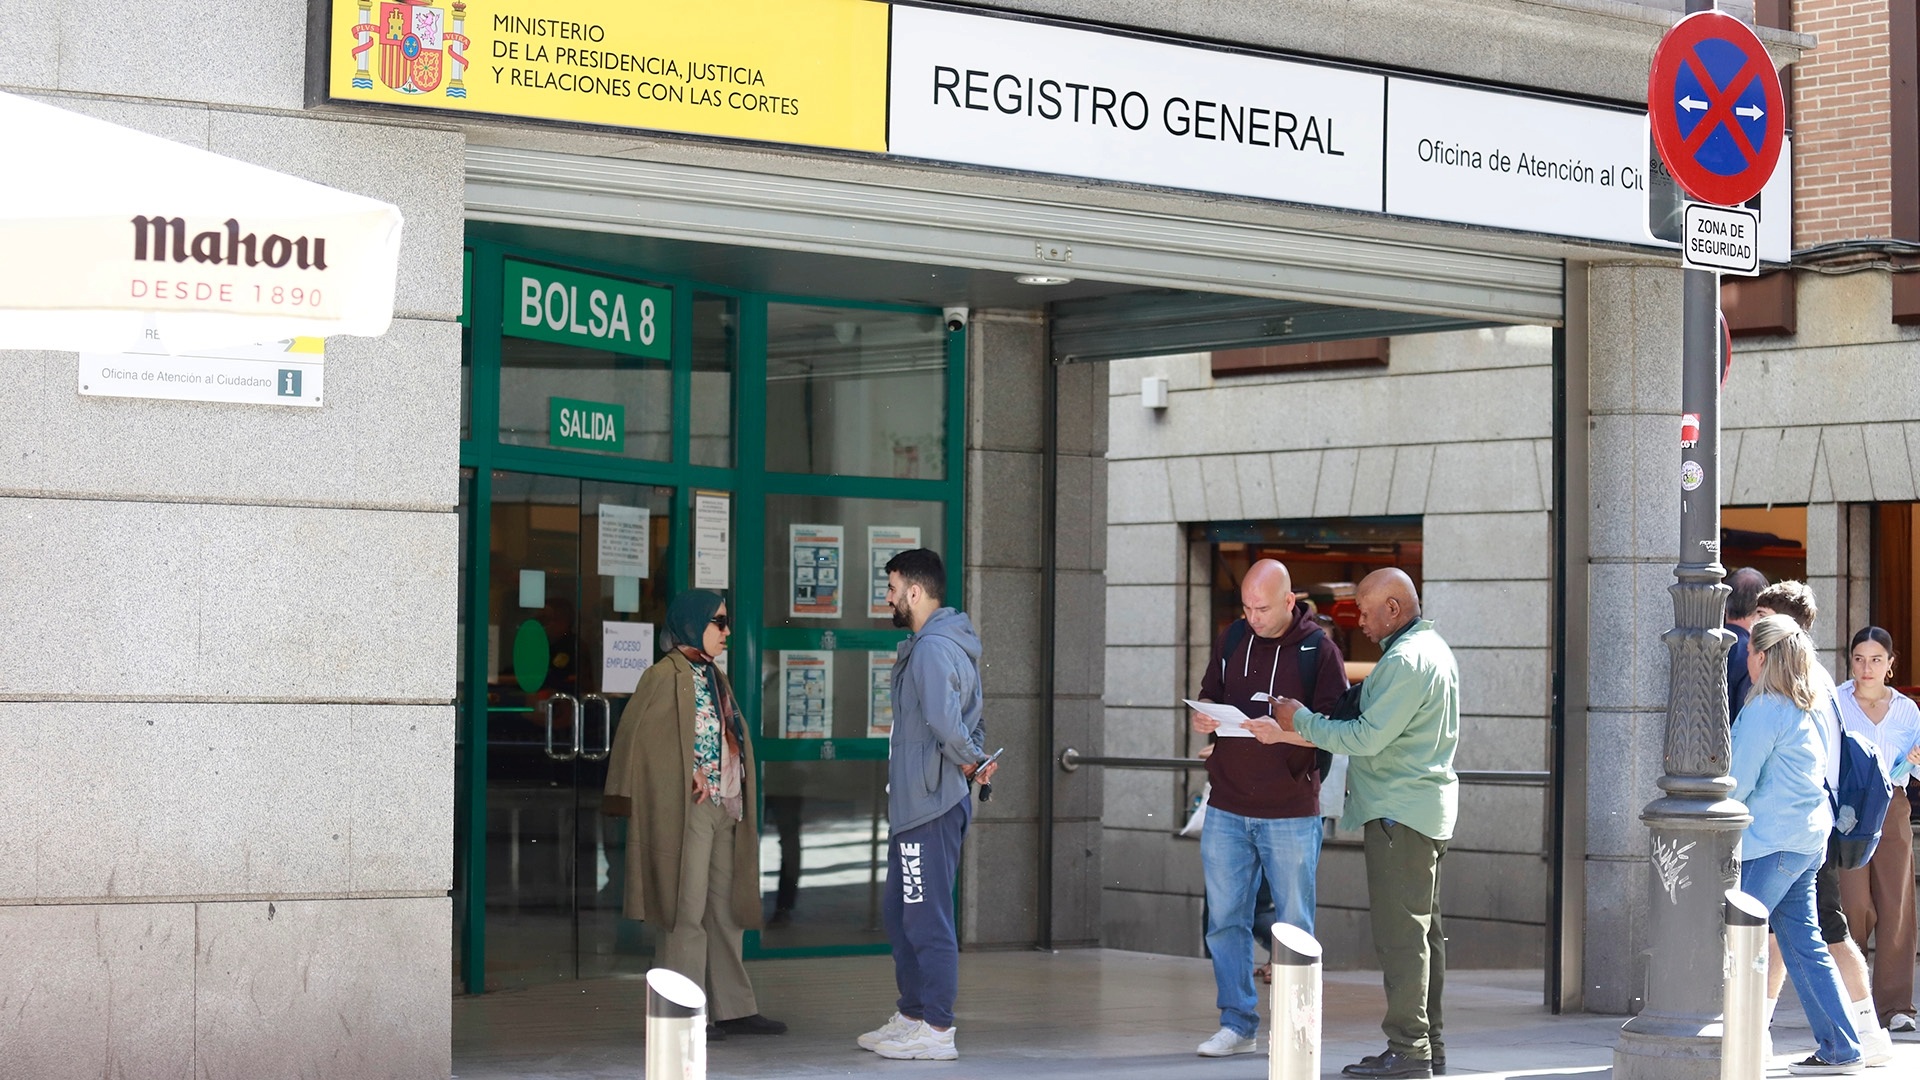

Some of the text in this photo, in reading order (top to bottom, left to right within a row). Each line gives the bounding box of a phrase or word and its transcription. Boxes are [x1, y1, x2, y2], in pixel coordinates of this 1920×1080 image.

[493, 13, 605, 43] MINISTERIO
[492, 40, 766, 87] DE LA PRESIDENCIA, JUSTICIA
[491, 66, 799, 116] Y RELACIONES CON LAS CORTES
[933, 65, 1345, 157] REGISTRO GENERAL
[1417, 138, 1482, 169] Oficina
[1488, 149, 1511, 172] de
[1516, 152, 1594, 184] Atención
[1600, 164, 1615, 187] al
[130, 214, 328, 271] Mahou
[1697, 218, 1744, 239] ZONA DE
[1691, 237, 1751, 260] SEGURIDAD
[131, 279, 322, 308] DESDE 1890
[521, 276, 656, 346] BOLSA 8
[101, 367, 272, 387] Oficina de Atención al Ciudadano
[559, 408, 616, 442] SALIDA
[612, 640, 641, 652] ACCESO
[605, 657, 648, 670] EMPLEAD@S
